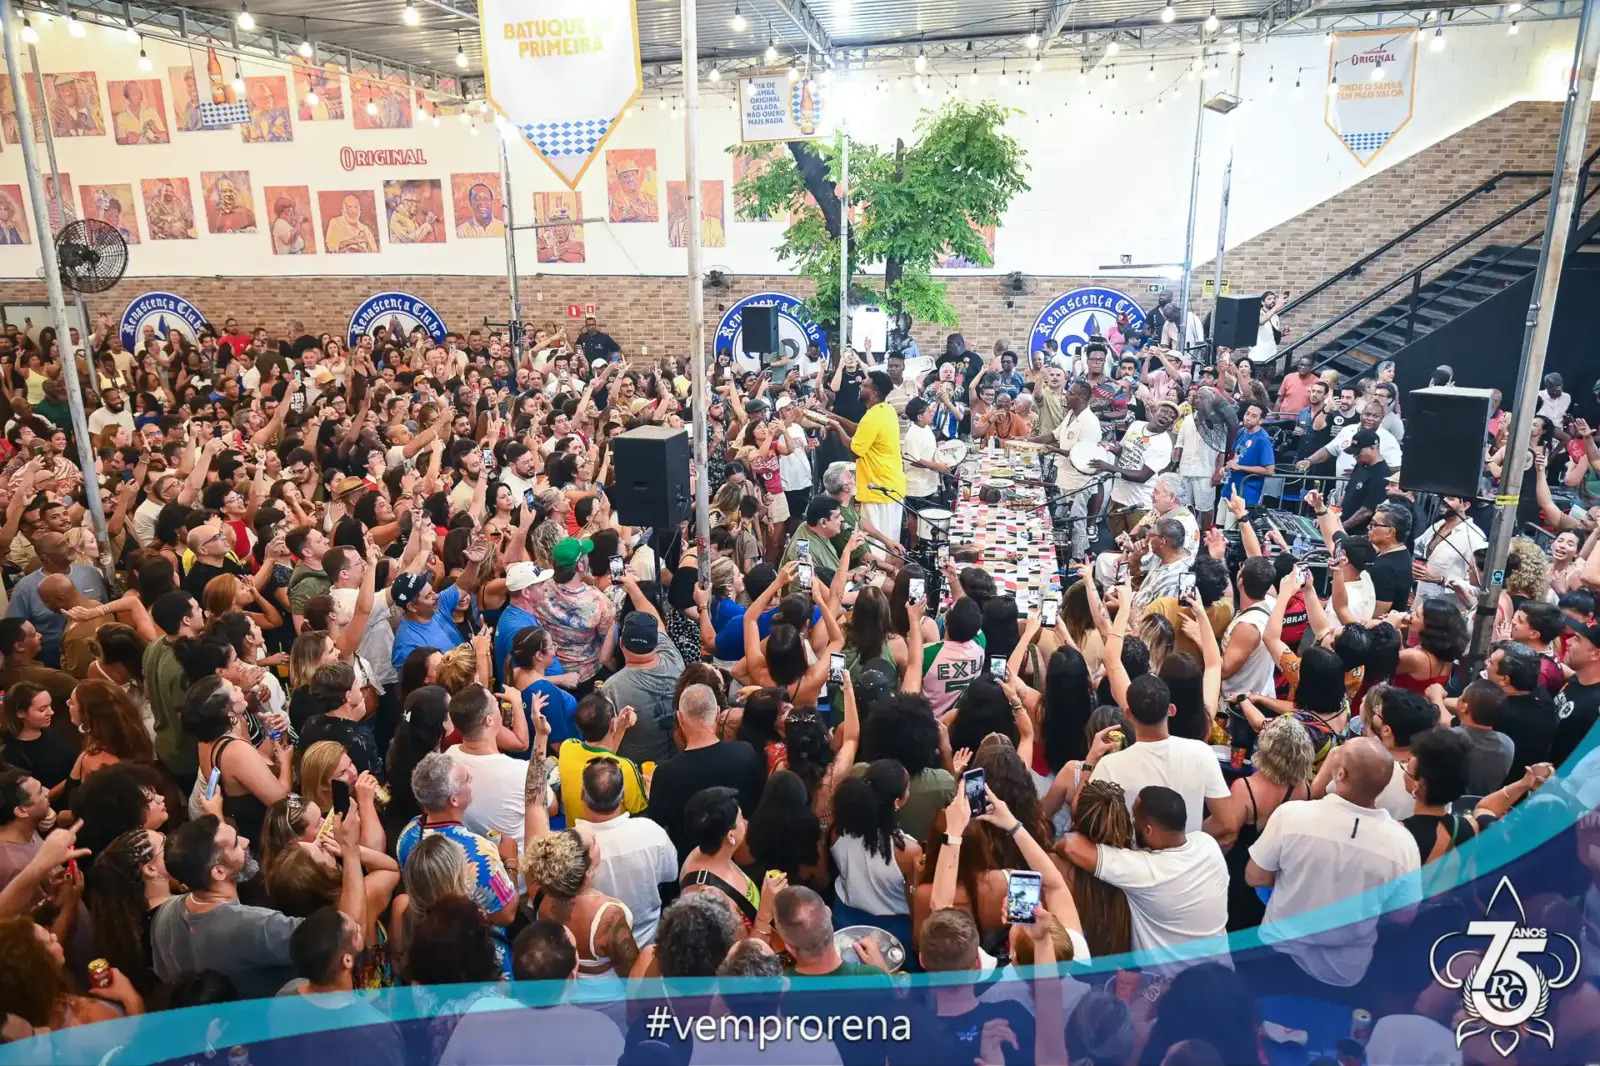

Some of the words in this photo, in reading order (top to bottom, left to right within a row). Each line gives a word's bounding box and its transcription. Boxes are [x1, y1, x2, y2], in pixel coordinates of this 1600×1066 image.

[503, 17, 587, 39] BATUQUE
[518, 36, 605, 58] PRIMEIRA
[1351, 54, 1396, 66] ORIGINAL
[1364, 82, 1373, 91] O
[1376, 89, 1404, 98] VALOR
[750, 96, 781, 104] ORIGINAL
[762, 109, 786, 118] QUERO
[122, 297, 175, 336] Renascença
[177, 302, 202, 334] Club
[351, 297, 410, 335] Renascença
[413, 303, 441, 337] Clube
[1035, 294, 1112, 336] Renascença
[1115, 299, 1144, 332] Club
[937, 655, 984, 680] EXU
